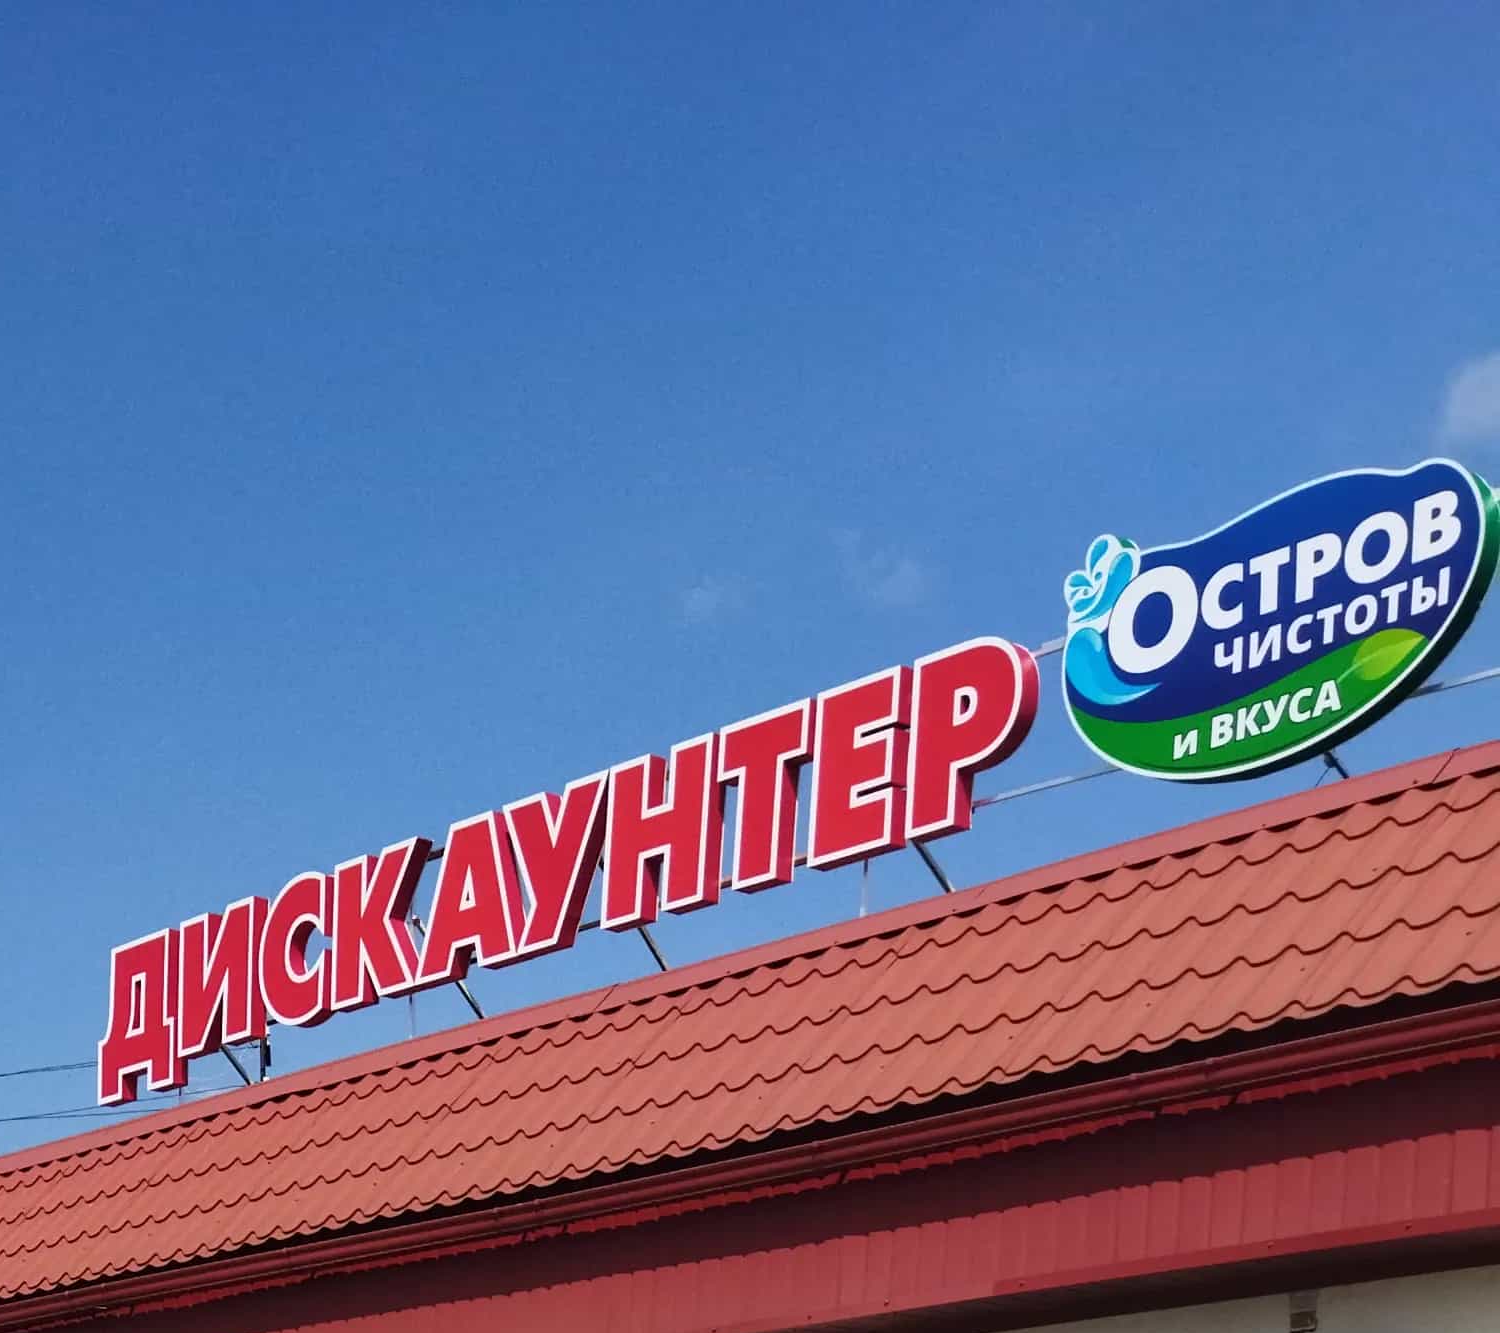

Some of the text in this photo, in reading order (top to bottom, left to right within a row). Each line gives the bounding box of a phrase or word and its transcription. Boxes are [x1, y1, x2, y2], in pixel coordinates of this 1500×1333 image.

[1213, 567, 1451, 675] ЧИСТОТЫ
[1209, 680, 1342, 750] ВКУСА
[98, 635, 1040, 1105] ДИСКАУНТЕР
